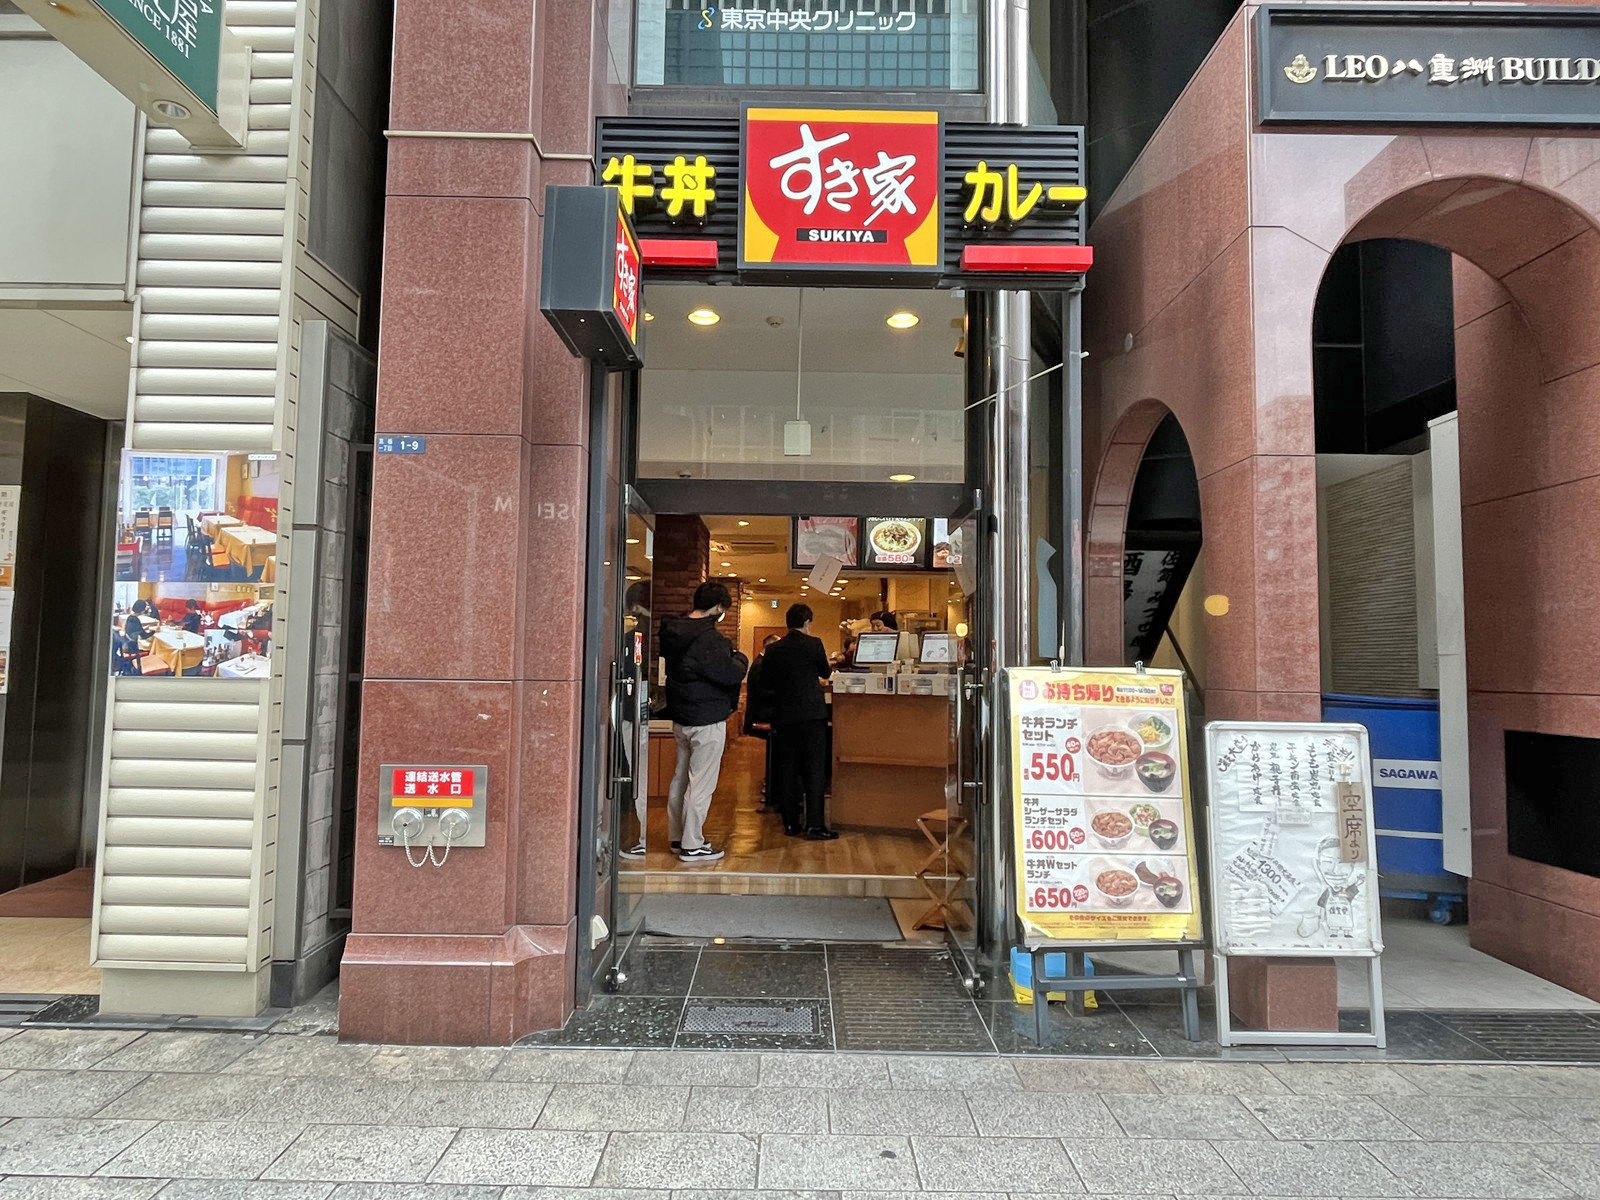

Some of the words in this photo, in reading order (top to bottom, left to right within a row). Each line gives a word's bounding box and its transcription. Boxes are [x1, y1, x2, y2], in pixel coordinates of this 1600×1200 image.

[720, 8, 916, 32] 東京中央クリニック
[165, 24, 190, 59] 1881
[769, 123, 919, 226] すき家
[602, 153, 717, 217] 牛丼
[962, 160, 1088, 224] カレー
[807, 229, 875, 243] SUKIYA
[400, 440, 419, 451] 1-9
[1042, 682, 1115, 702] お持ち帰り
[1021, 716, 1078, 730] 牛丼ランチ
[1022, 730, 1054, 742] セット
[1030, 752, 1080, 782] 550円
[1379, 768, 1439, 780] SAGAWA
[404, 771, 463, 783] 連結送水管
[1023, 797, 1039, 806] 牛丼
[1024, 807, 1078, 816] シーザーサラダ
[1024, 816, 1069, 825] ランチセット
[1031, 829, 1075, 850] 600円
[1027, 870, 1051, 879] ランチ
[1034, 887, 1078, 908] 650円
